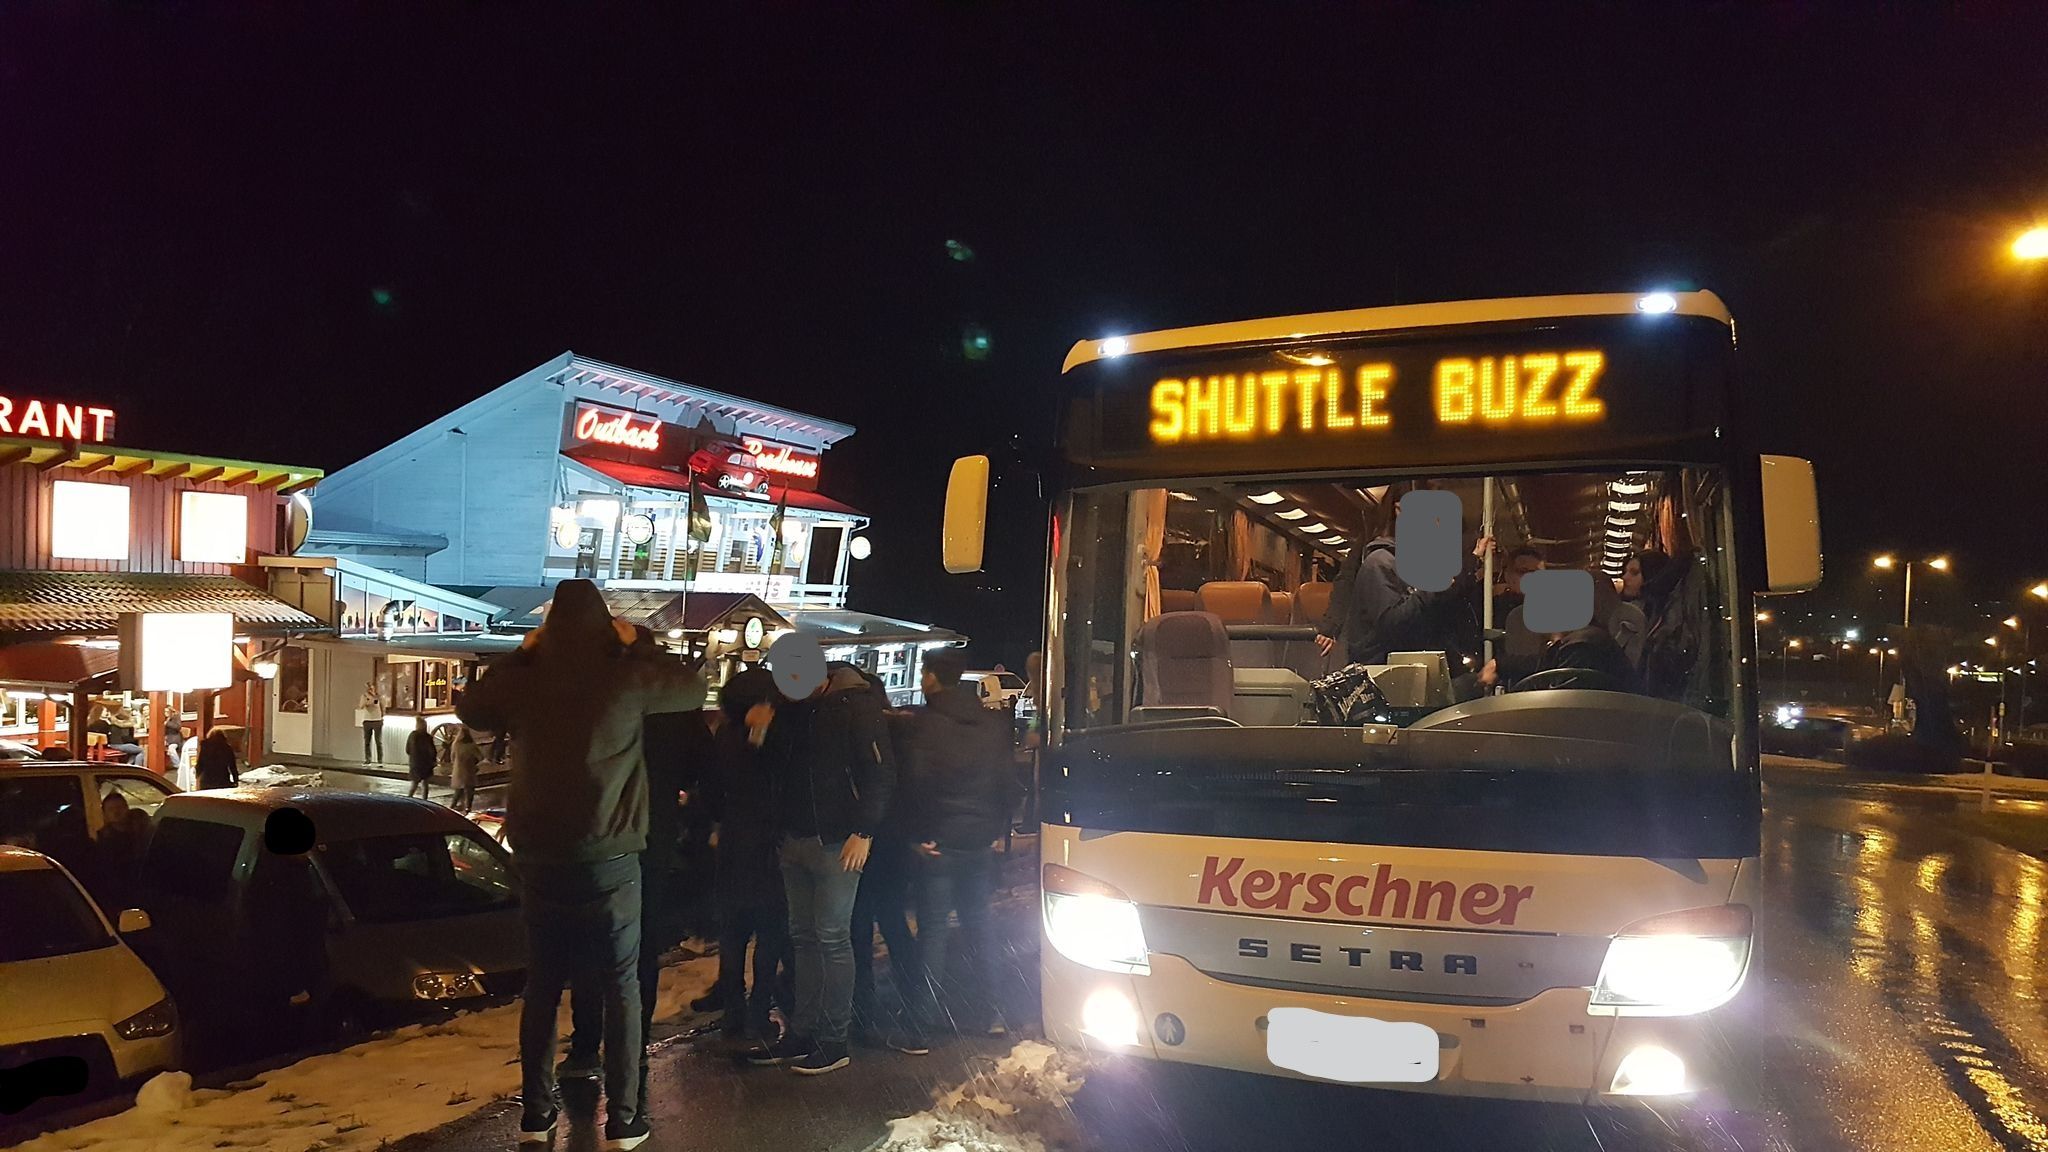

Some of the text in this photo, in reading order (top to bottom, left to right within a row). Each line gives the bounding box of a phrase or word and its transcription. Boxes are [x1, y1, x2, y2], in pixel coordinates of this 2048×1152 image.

[1150, 351, 1604, 442] SHUTTLE BUZZ
[577, 408, 662, 450] Outback
[1197, 855, 1535, 926] Kerschner
[1237, 937, 1478, 976] SETRA
